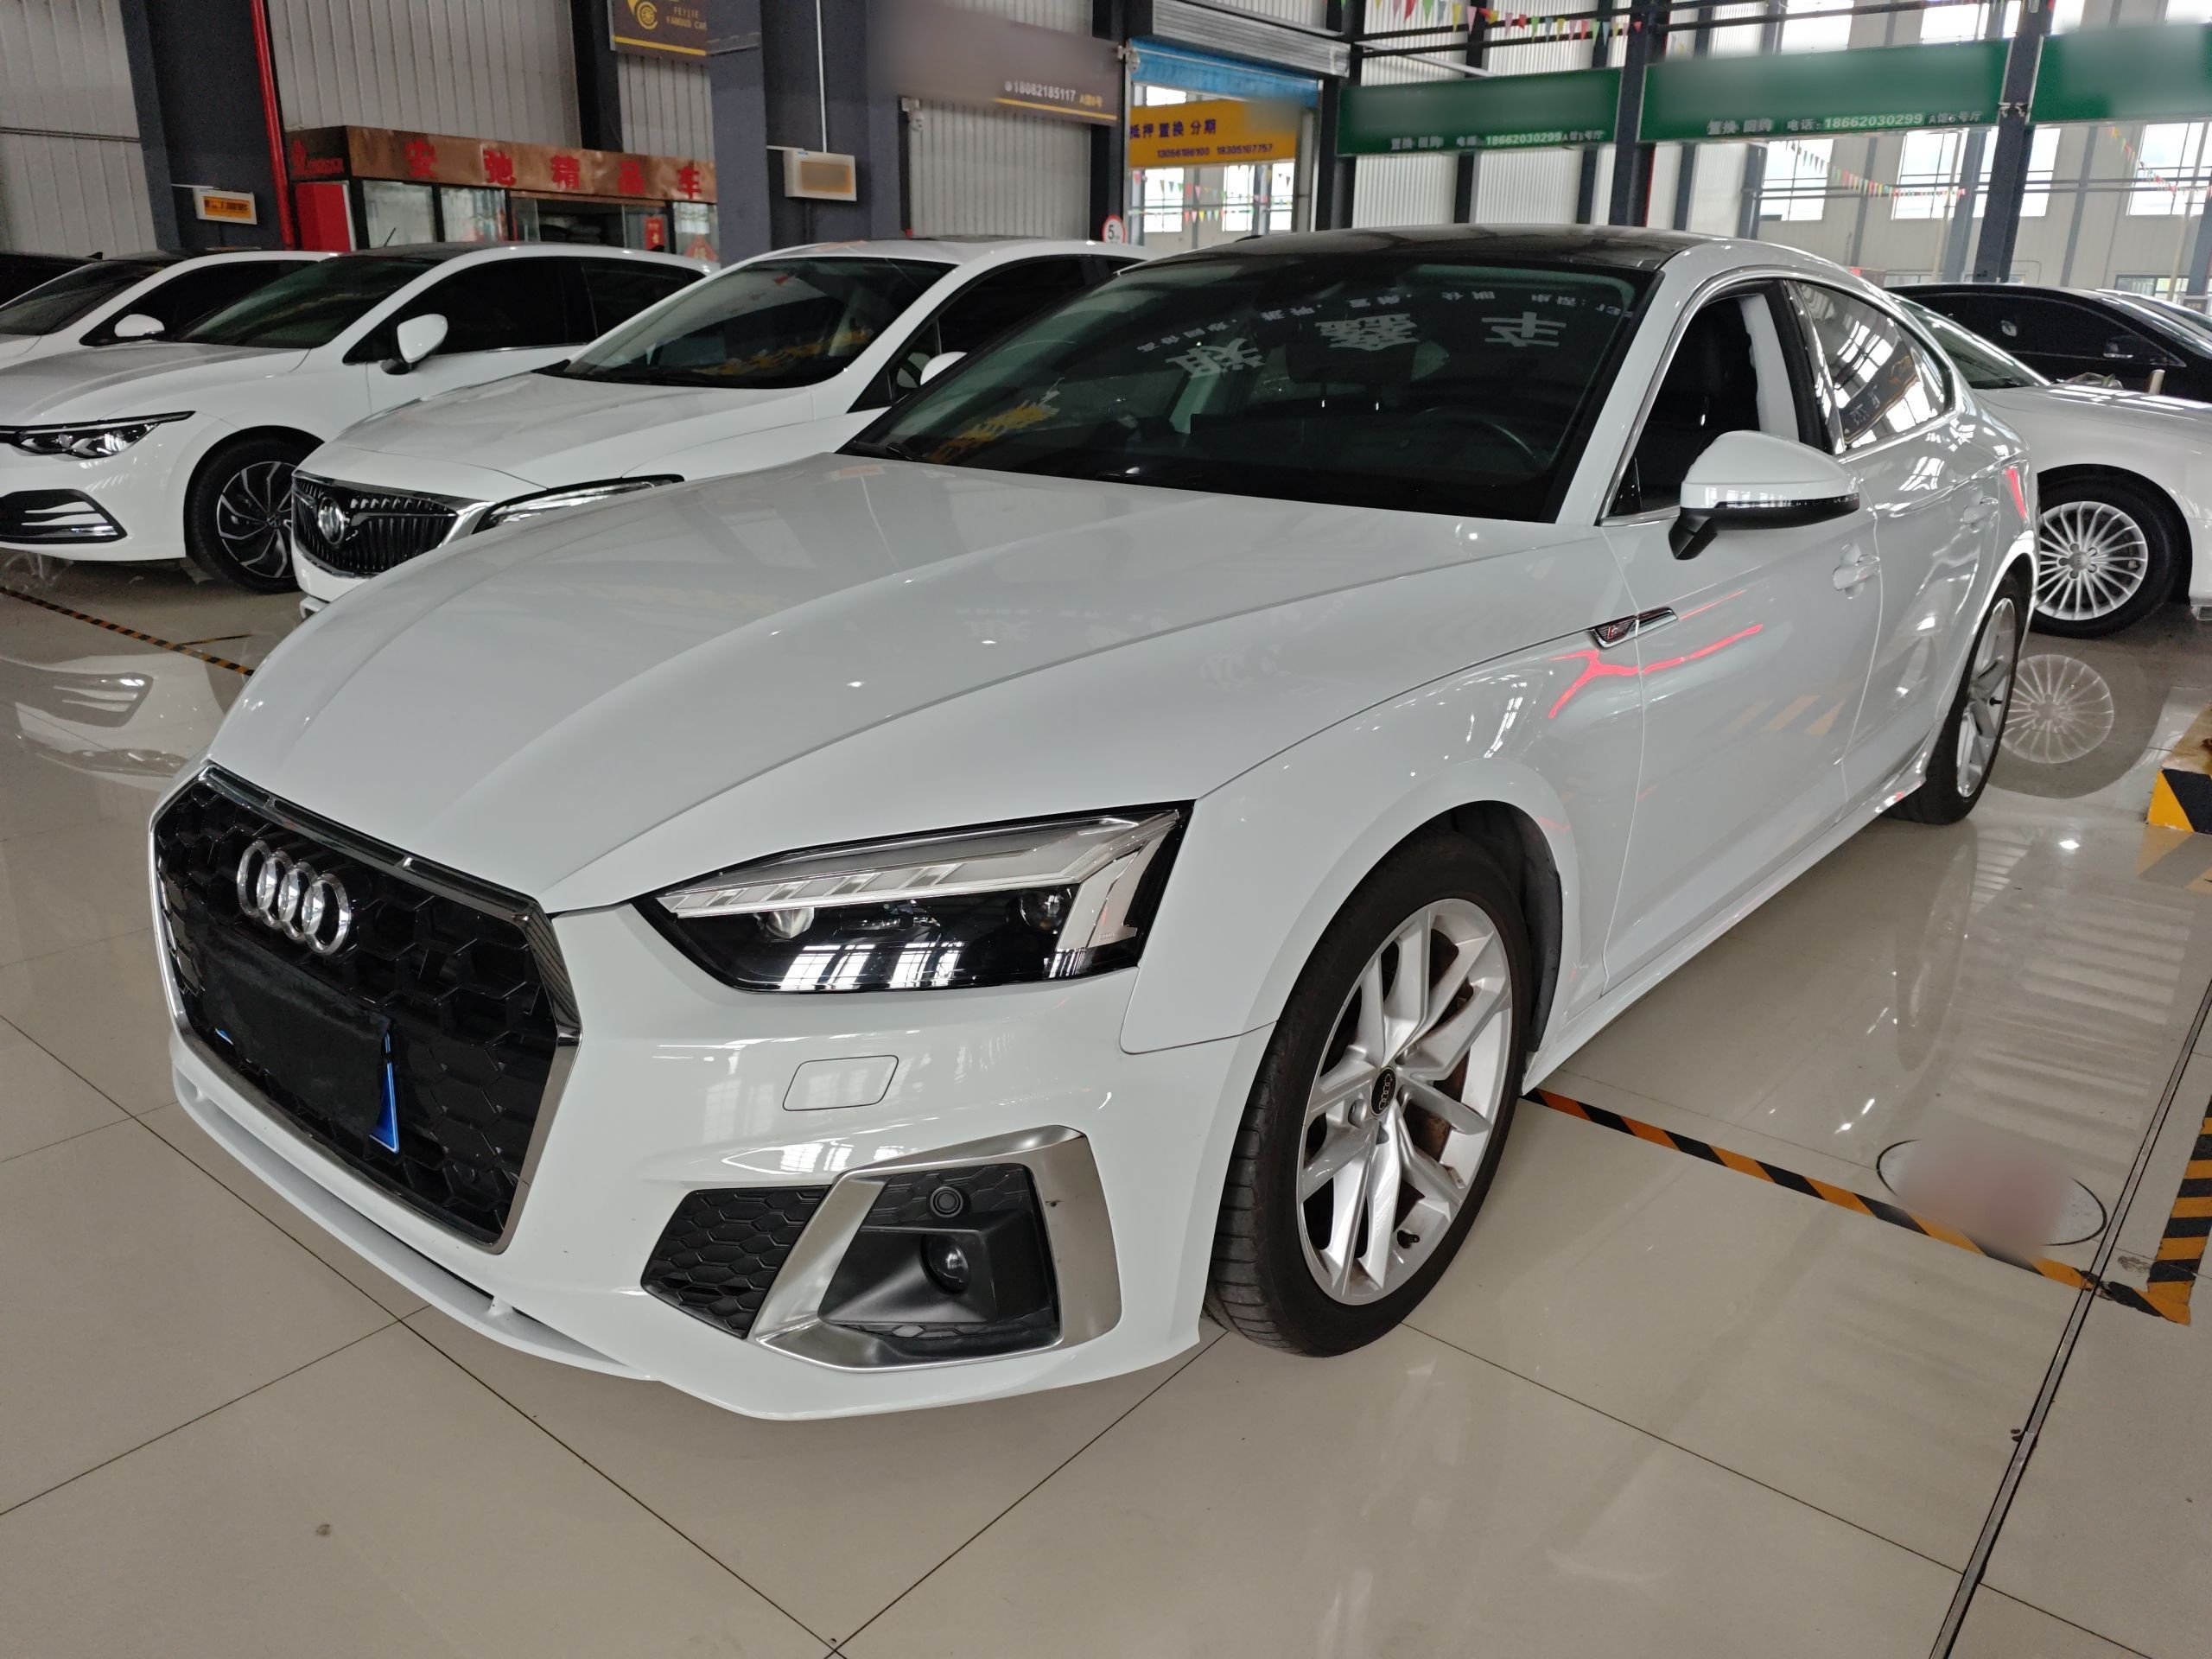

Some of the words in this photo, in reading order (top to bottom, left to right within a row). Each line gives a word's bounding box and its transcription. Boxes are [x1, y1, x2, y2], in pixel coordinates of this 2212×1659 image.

[1191, 118, 1217, 135] 分期
[1824, 112, 1923, 129] 18662030299
[1485, 131, 1562, 146] 18662030299
[1108, 224, 1115, 240] 5
